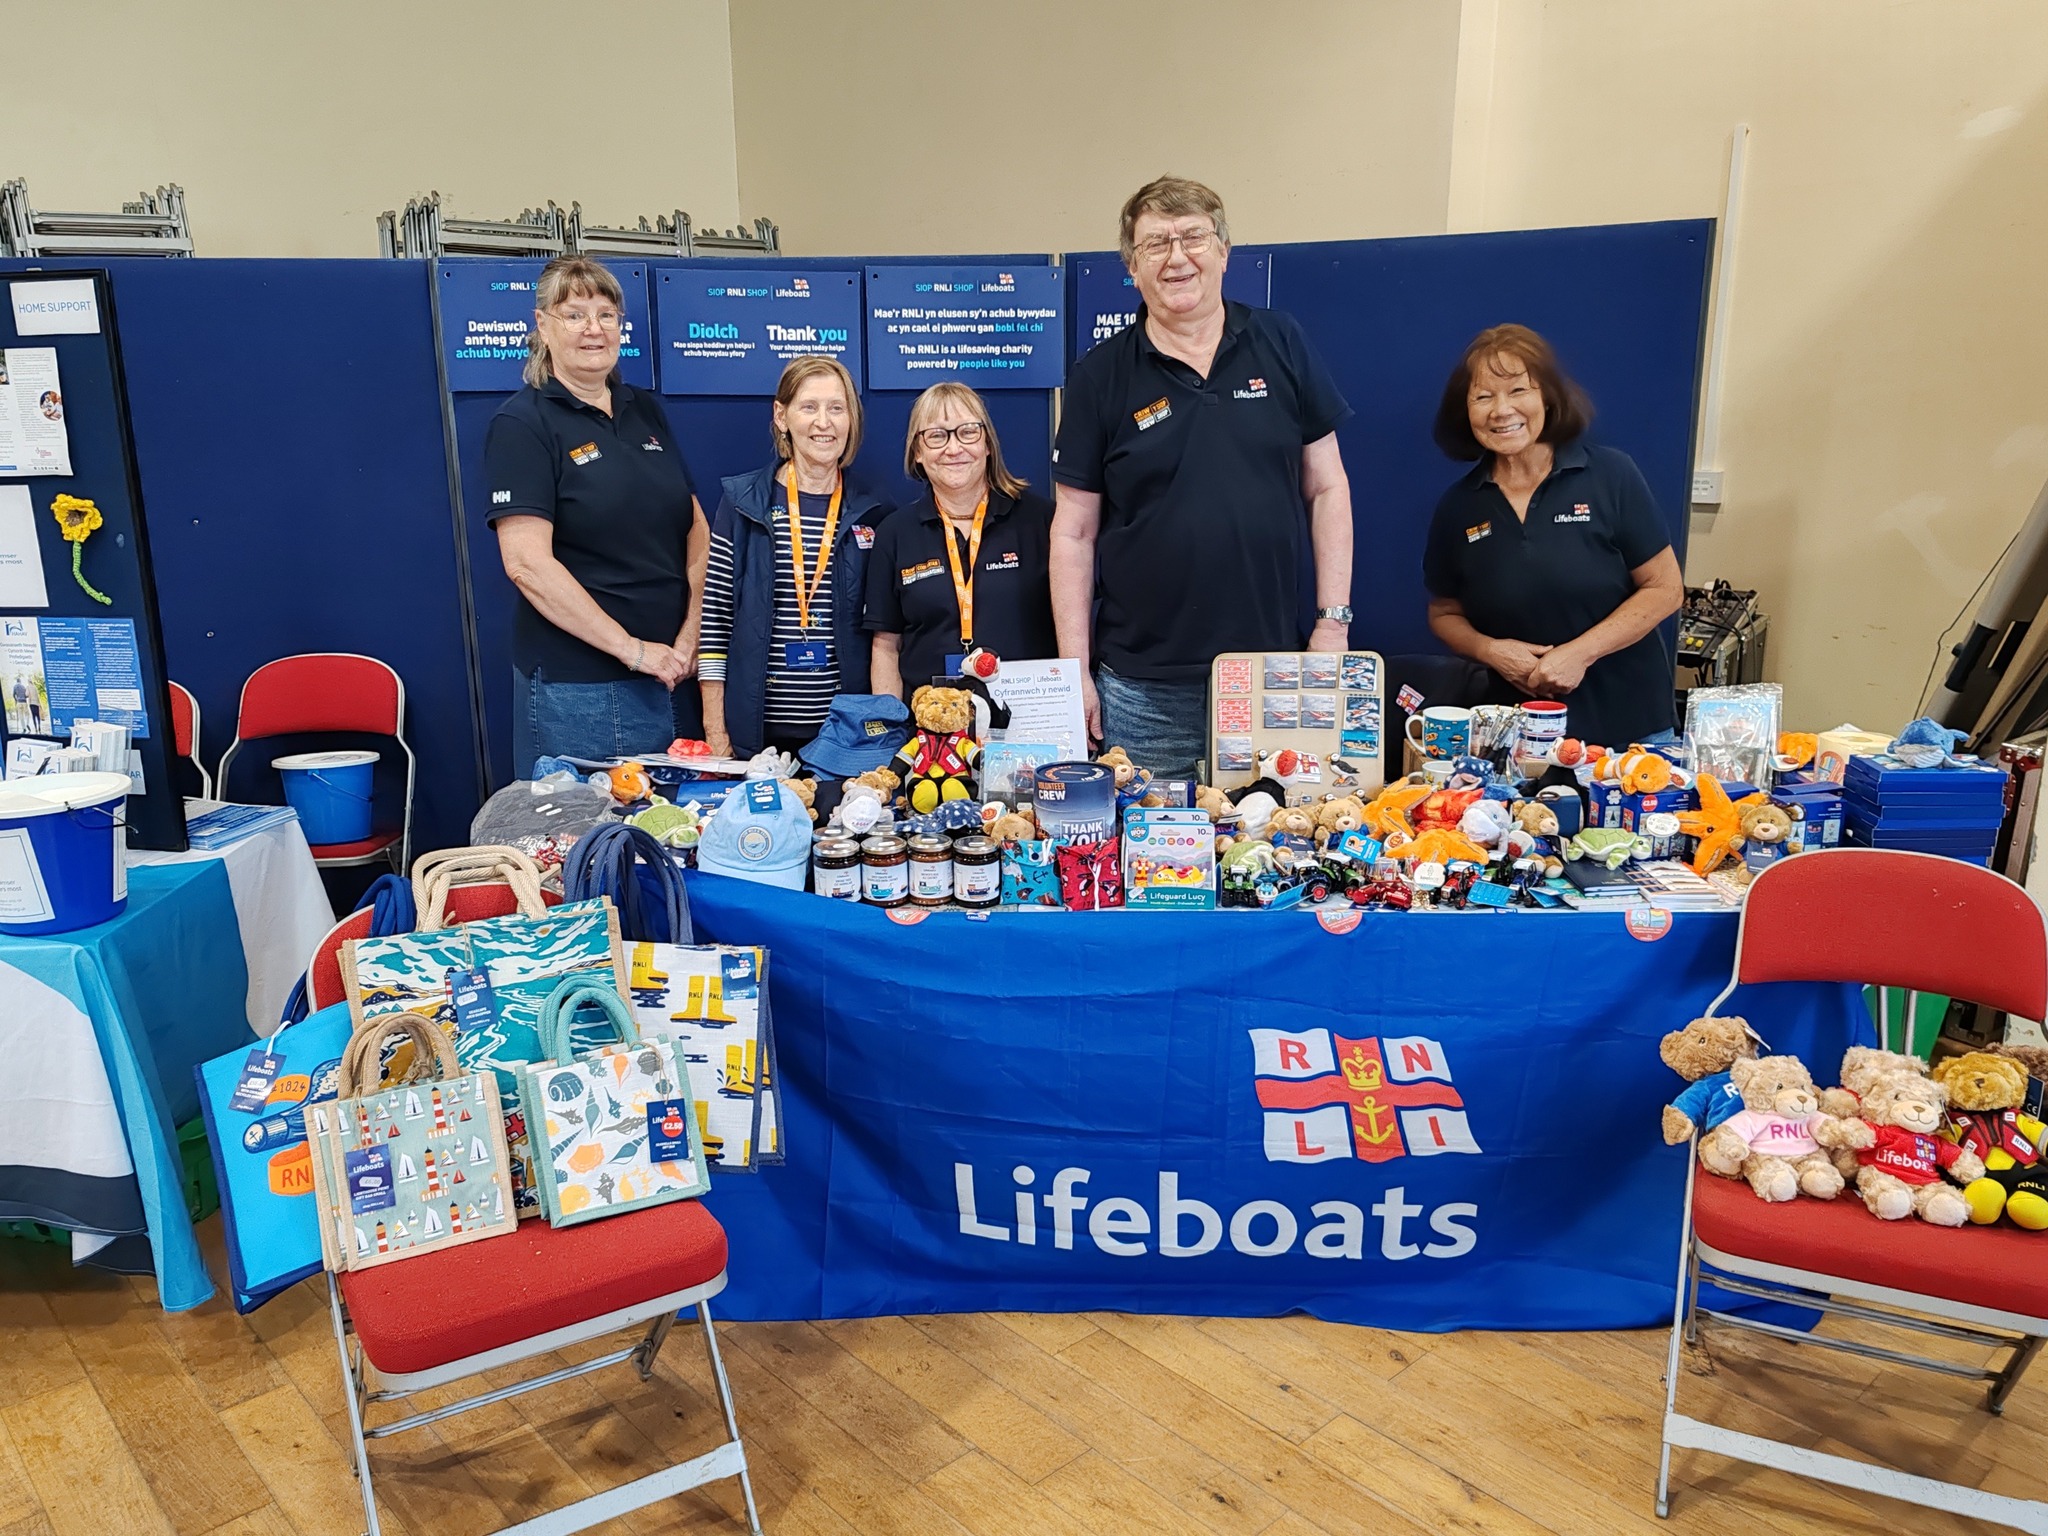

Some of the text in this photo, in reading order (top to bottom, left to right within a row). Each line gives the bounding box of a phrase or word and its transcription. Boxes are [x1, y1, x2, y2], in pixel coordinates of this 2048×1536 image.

[491, 282, 509, 290] SIOP
[510, 282, 530, 290] RNLI
[982, 284, 1015, 292] Lifeboats
[708, 288, 810, 297] SIOP RNLI SHOP Lifeboats
[19, 301, 91, 313] HOME SUPPORT
[874, 308, 1056, 320] Mae'r RNLI yn elusen sy'n achub bywydau
[1097, 314, 1121, 326] MAE
[468, 321, 527, 332] Dewiswch
[689, 324, 738, 339] Diolch
[900, 326, 910, 334] yn
[912, 324, 930, 333] cael
[932, 324, 940, 332] ei
[942, 324, 976, 334] phweru
[978, 326, 994, 334] gan
[996, 324, 1015, 332] bobl
[1017, 324, 1029, 332] fel
[1030, 324, 1043, 332] chi
[766, 325, 847, 344] Thank you
[1093, 327, 1111, 338] O'R
[465, 335, 507, 348] anrheg
[687, 342, 705, 350] siopa
[734, 342, 751, 350] helpu
[456, 348, 491, 359] achub
[784, 344, 811, 352] shopping
[899, 345, 916, 354] The
[918, 345, 939, 354] RNLI
[941, 345, 949, 354] is
[958, 345, 1000, 356] lifesaving
[1002, 345, 1032, 355] charity
[907, 360, 1025, 370] powered by people like you
[1234, 390, 1268, 398] Lifeboats
[1555, 514, 1590, 523] Lifeboats
[986, 562, 1019, 570] Lifeboats
[994, 687, 1040, 698] Cyfrannwch
[1049, 685, 1070, 693] newid
[1039, 791, 1065, 800] CREW
[1063, 821, 1102, 834] THANK
[459, 983, 487, 993] Lifeboats
[1279, 1038, 1431, 1073] R N
[248, 1065, 274, 1075] Lifeboats
[280, 1081, 306, 1093] 1824
[1770, 1123, 1810, 1140] RNL
[1296, 1120, 1325, 1156] L
[2014, 1137, 2031, 1152] RNLI
[353, 1162, 384, 1173] Lifeboats
[282, 1164, 309, 1188] RN
[2018, 1181, 2046, 1191] RNLI
[955, 1162, 1478, 1261] Lifeboats
